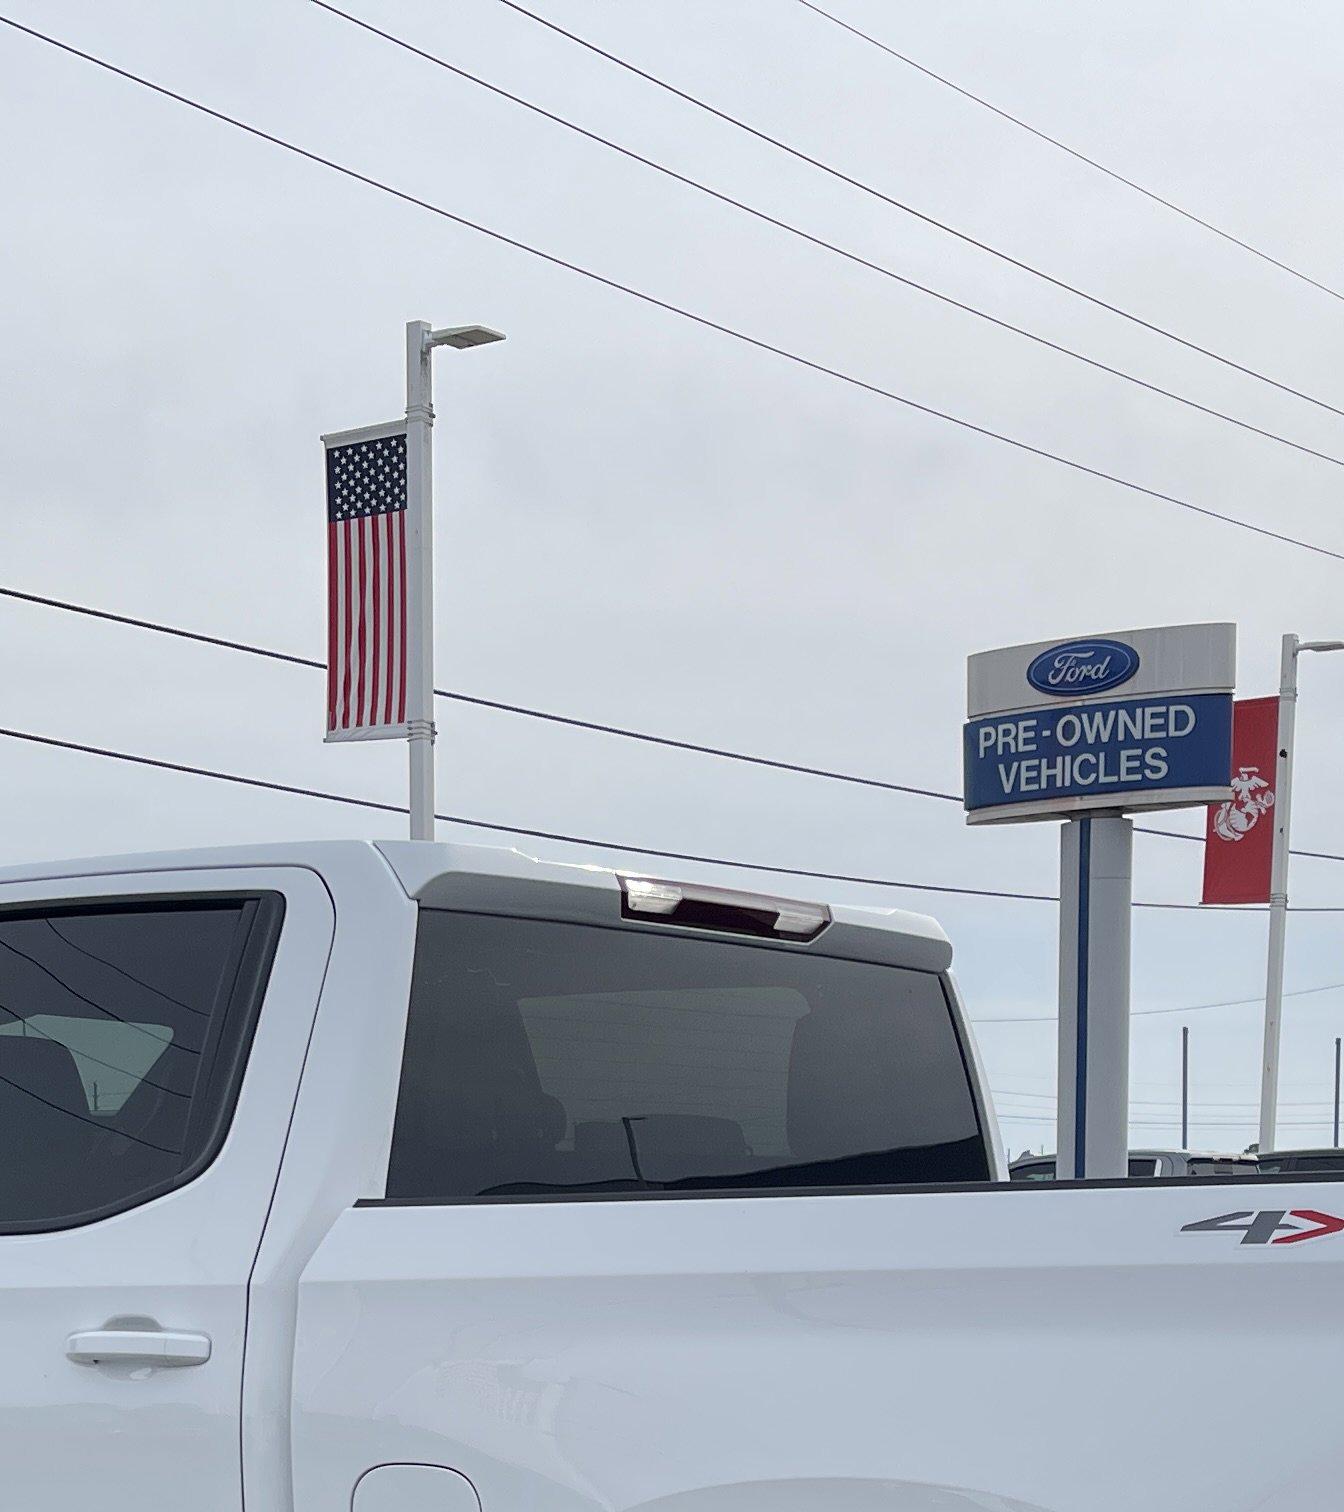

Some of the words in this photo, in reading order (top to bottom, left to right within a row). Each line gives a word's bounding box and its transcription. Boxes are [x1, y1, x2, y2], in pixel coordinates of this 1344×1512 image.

[1048, 651, 1112, 685] Ford
[979, 705, 1196, 758] PRE-OWNED
[998, 747, 1169, 794] VEHICLES
